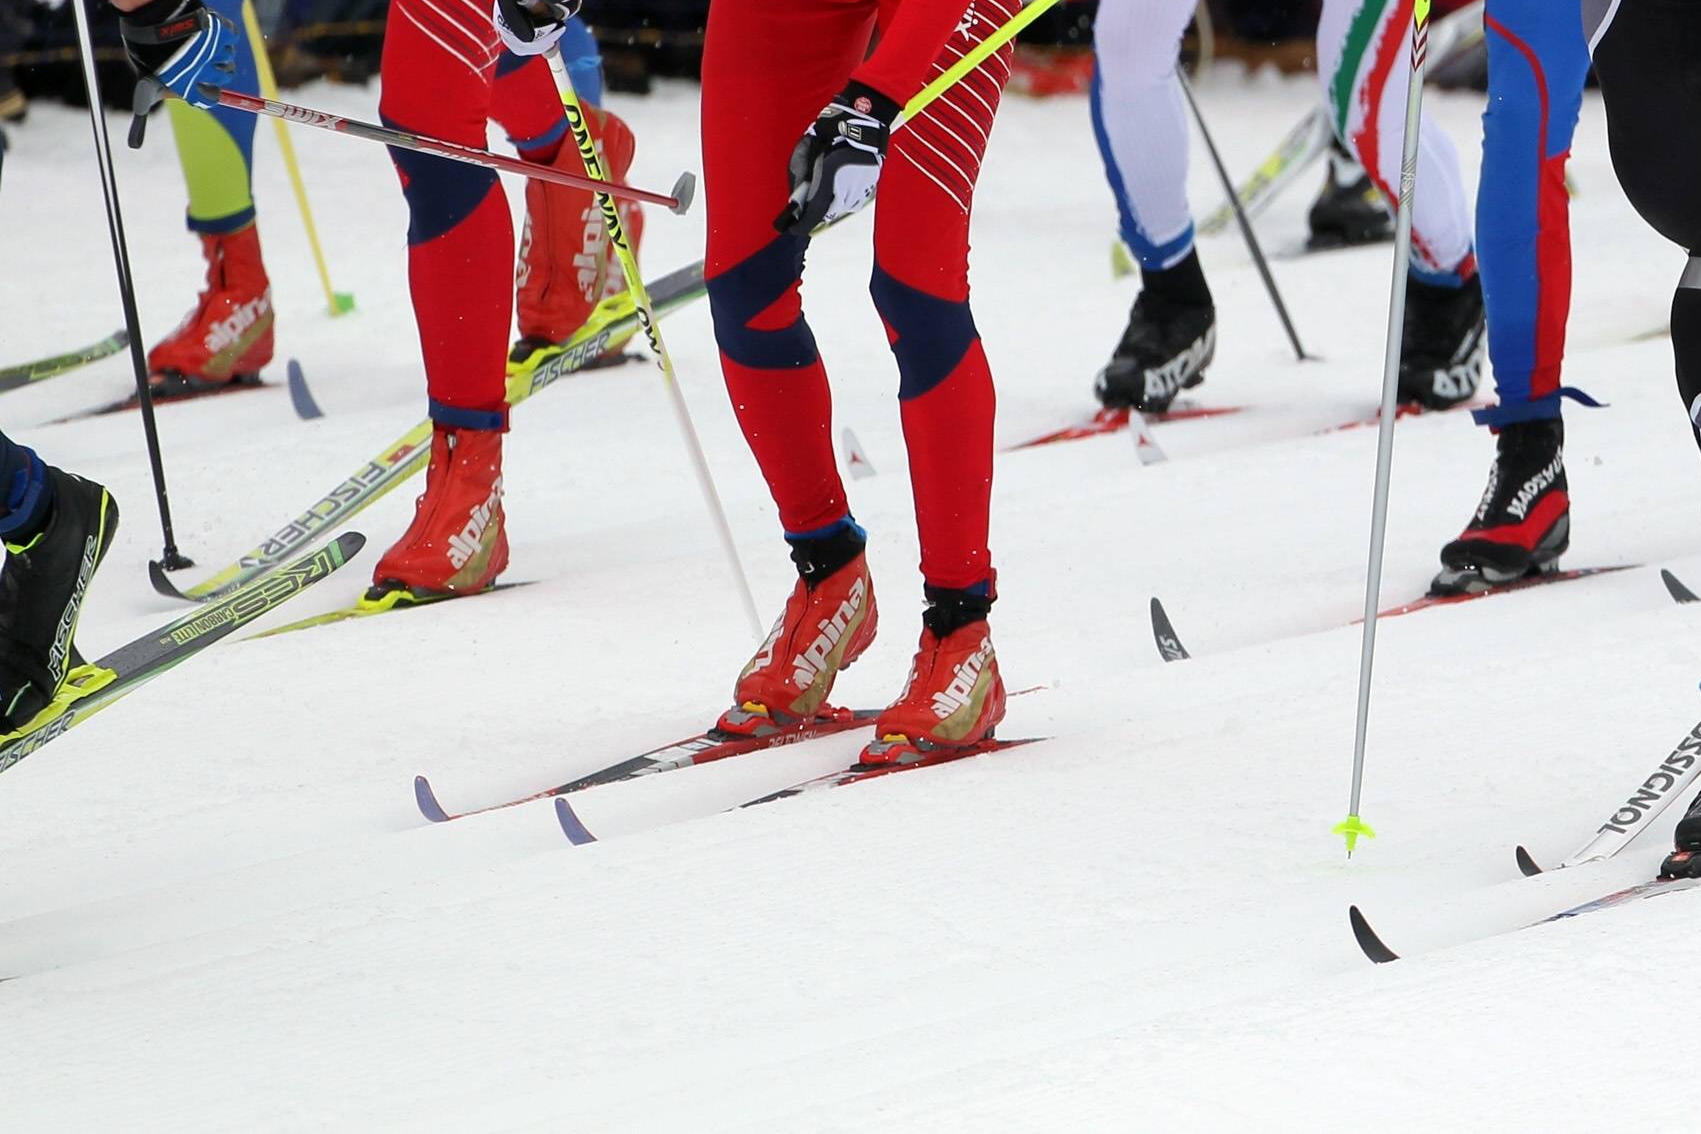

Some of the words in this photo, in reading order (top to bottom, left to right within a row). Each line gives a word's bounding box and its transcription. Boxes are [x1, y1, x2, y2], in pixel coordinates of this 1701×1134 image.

[529, 330, 611, 396] FISCHER
[258, 460, 387, 557] FISCHER
[793, 577, 864, 690] alpina
[931, 637, 994, 719] alpina
